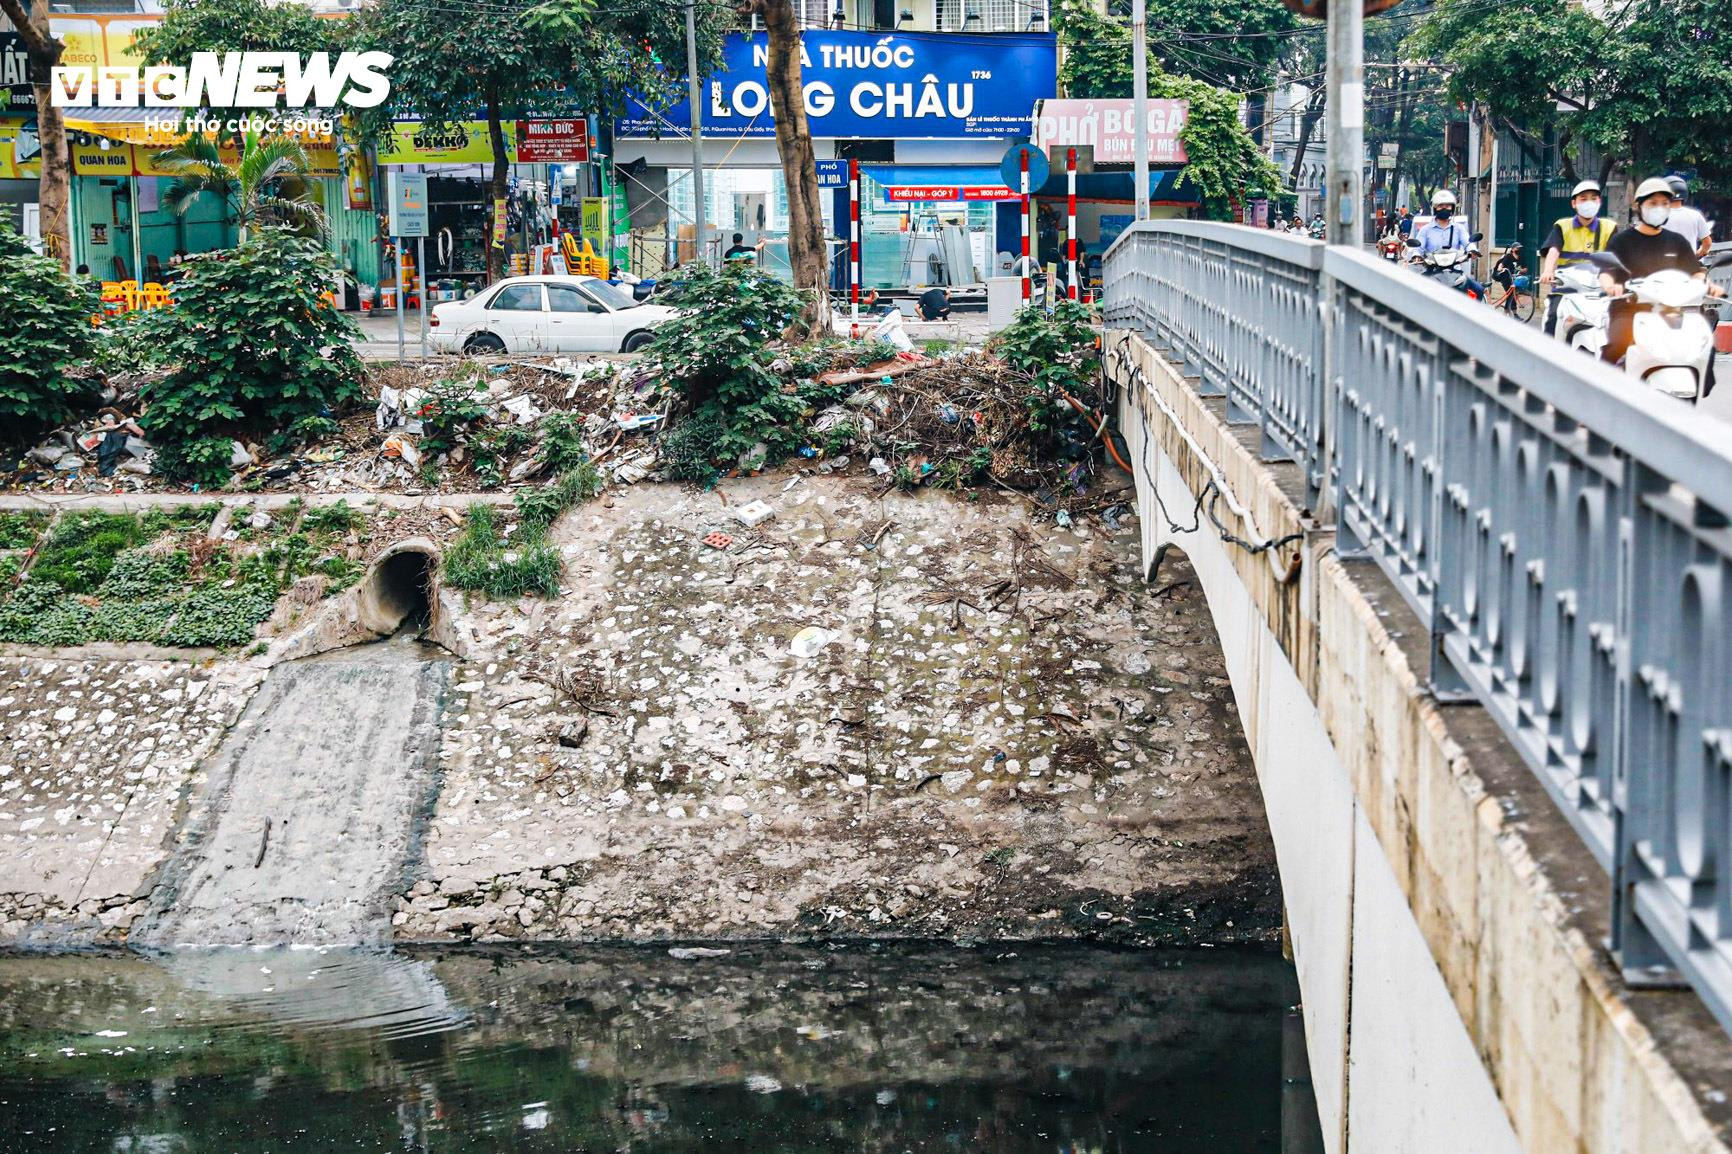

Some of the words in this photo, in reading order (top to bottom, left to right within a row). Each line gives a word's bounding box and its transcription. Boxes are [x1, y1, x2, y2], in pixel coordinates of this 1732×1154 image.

[60, 54, 97, 62] ABECO
[753, 37, 812, 68] NÀ
[820, 36, 915, 68] THUỐC
[0, 39, 28, 84] ẤT
[971, 70, 991, 79] 1736
[711, 80, 835, 118] LOG
[850, 73, 974, 118] CHÂU
[556, 122, 574, 134] ĐỨC
[1104, 136, 1127, 152] BÚN
[80, 156, 105, 166] QUAN
[107, 156, 127, 166] HOA
[820, 162, 837, 171] PHỐ
[827, 174, 841, 185] HOA
[894, 187, 912, 197] KHIẾU
[913, 189, 926, 199] NẠI
[931, 189, 947, 197] GÓP
